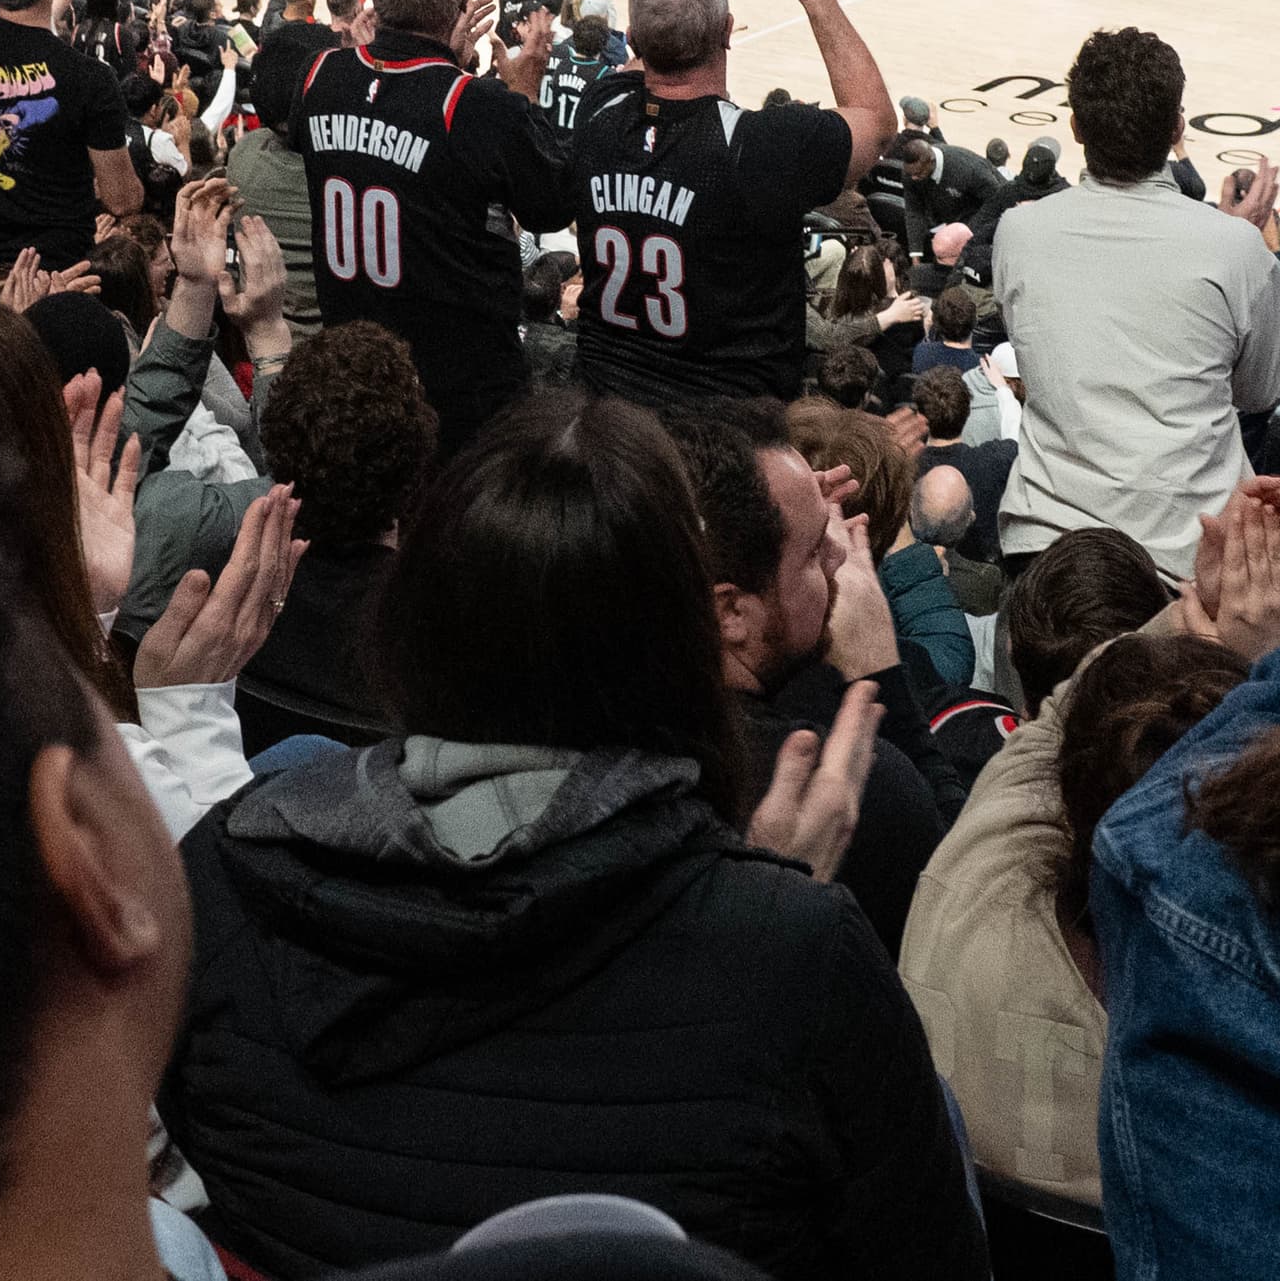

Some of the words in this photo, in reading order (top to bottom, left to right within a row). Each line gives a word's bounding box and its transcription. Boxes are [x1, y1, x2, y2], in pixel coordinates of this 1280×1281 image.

[558, 93, 581, 129] 17
[308, 113, 430, 174] HENDERSON
[590, 173, 695, 227] CLINGAN
[323, 176, 401, 289] 00
[595, 225, 688, 338] 23
